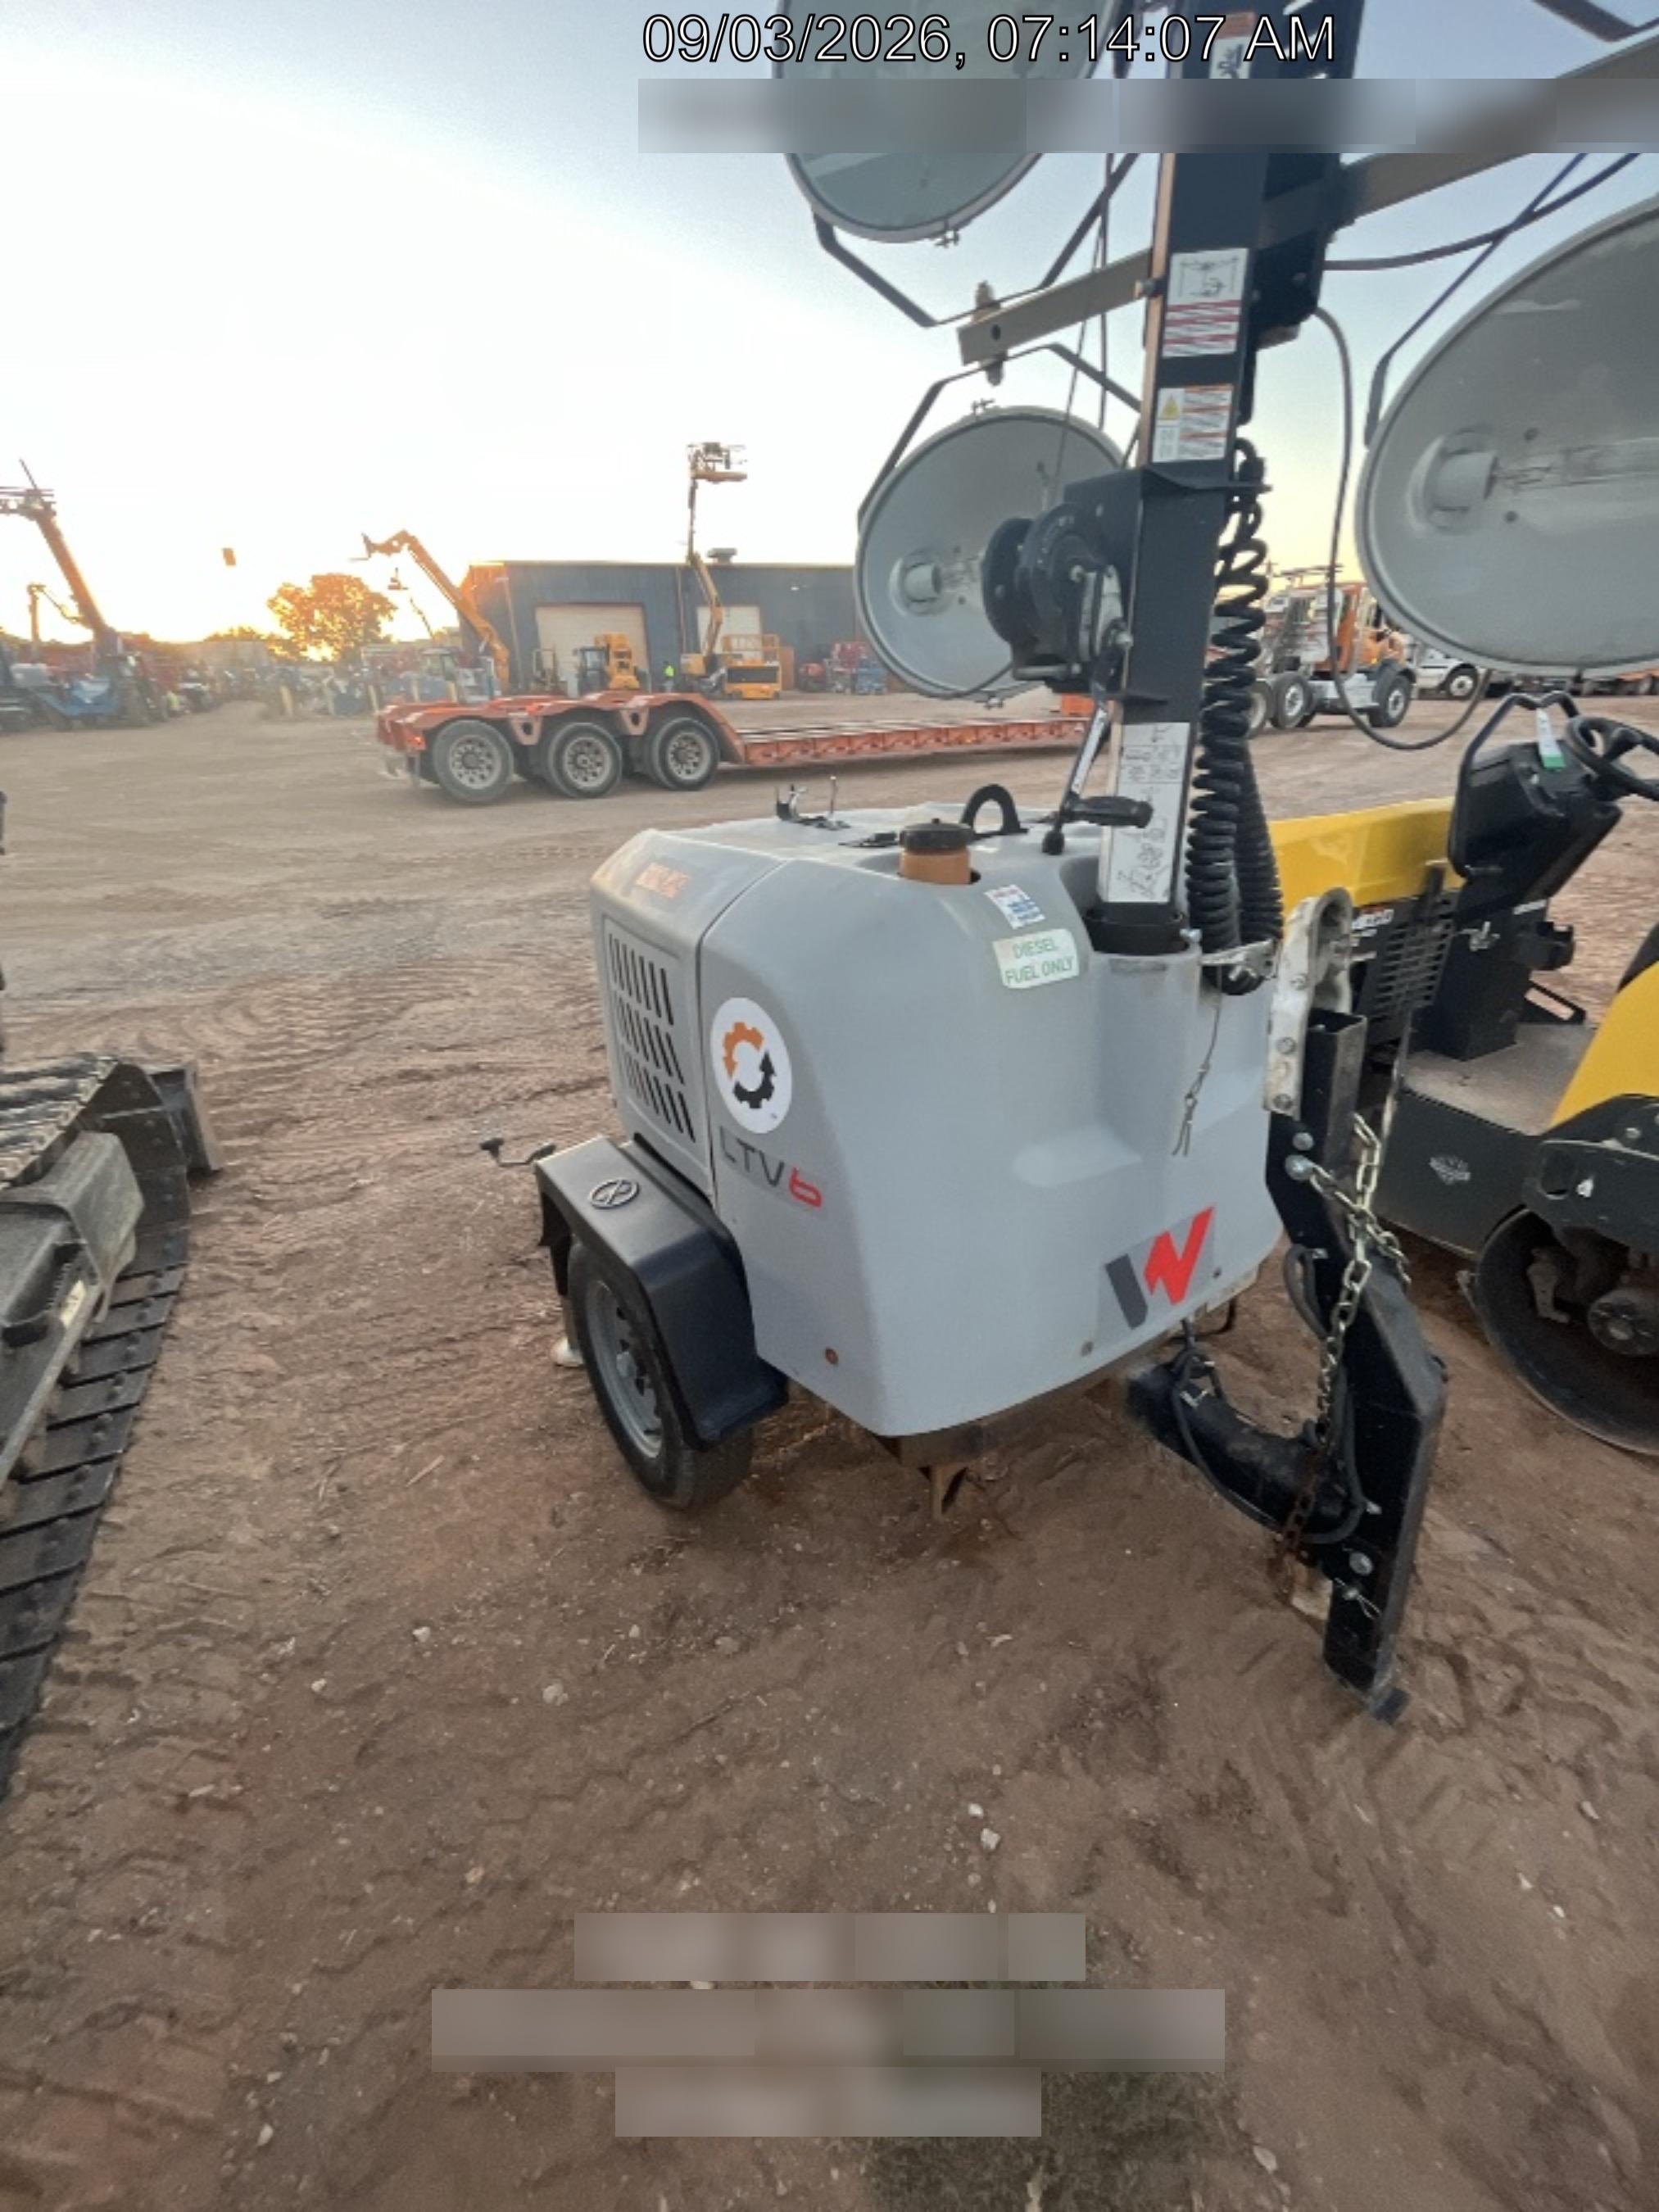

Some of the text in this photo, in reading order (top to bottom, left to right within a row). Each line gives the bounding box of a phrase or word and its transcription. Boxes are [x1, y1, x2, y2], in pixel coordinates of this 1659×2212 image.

[1013, 938, 1057, 959] DIESEL
[1005, 956, 1074, 985] FUEL ONLY
